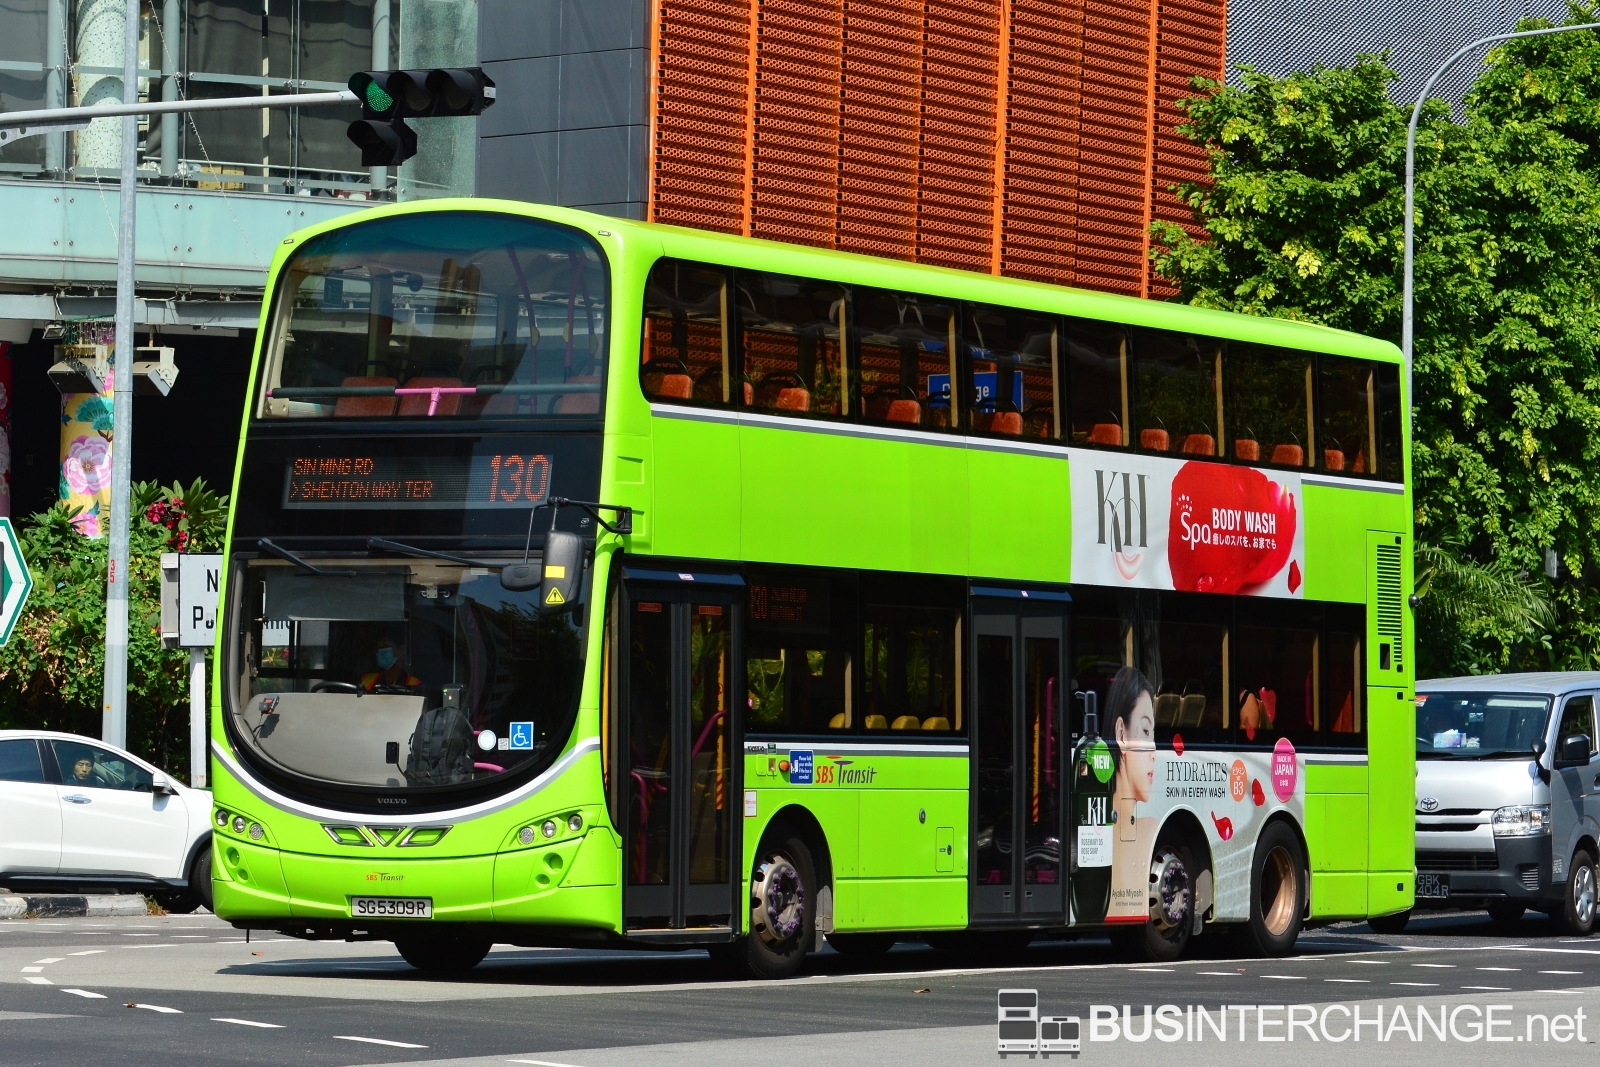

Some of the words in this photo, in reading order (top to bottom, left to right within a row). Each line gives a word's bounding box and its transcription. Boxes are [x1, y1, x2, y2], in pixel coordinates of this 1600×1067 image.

[294, 458, 317, 475] SIN
[319, 458, 352, 475] MING
[354, 458, 374, 475] RD
[489, 454, 549, 502] 130
[301, 481, 369, 498] SHENTON
[371, 481, 401, 498] WAY
[405, 480, 433, 498] TER
[1212, 507, 1241, 531] BODY
[1244, 510, 1277, 535] WASH
[1180, 511, 1211, 551] Spa
[1093, 754, 1110, 770] NEW
[1276, 755, 1287, 763] MADE
[815, 765, 835, 784] SBS
[833, 760, 877, 787] Transit
[1166, 761, 1228, 782] HYDRATES
[1274, 764, 1294, 776] JAPAN
[1166, 786, 1180, 798] SKIN
[1180, 787, 1188, 798] IN
[1188, 786, 1208, 798] EVERY
[1208, 787, 1226, 798] WASH
[1233, 781, 1244, 795] B3
[380, 872, 405, 882] Transit
[1417, 874, 1440, 886] GBK
[1417, 884, 1449, 897] 404R
[357, 900, 426, 915] SG5309R
